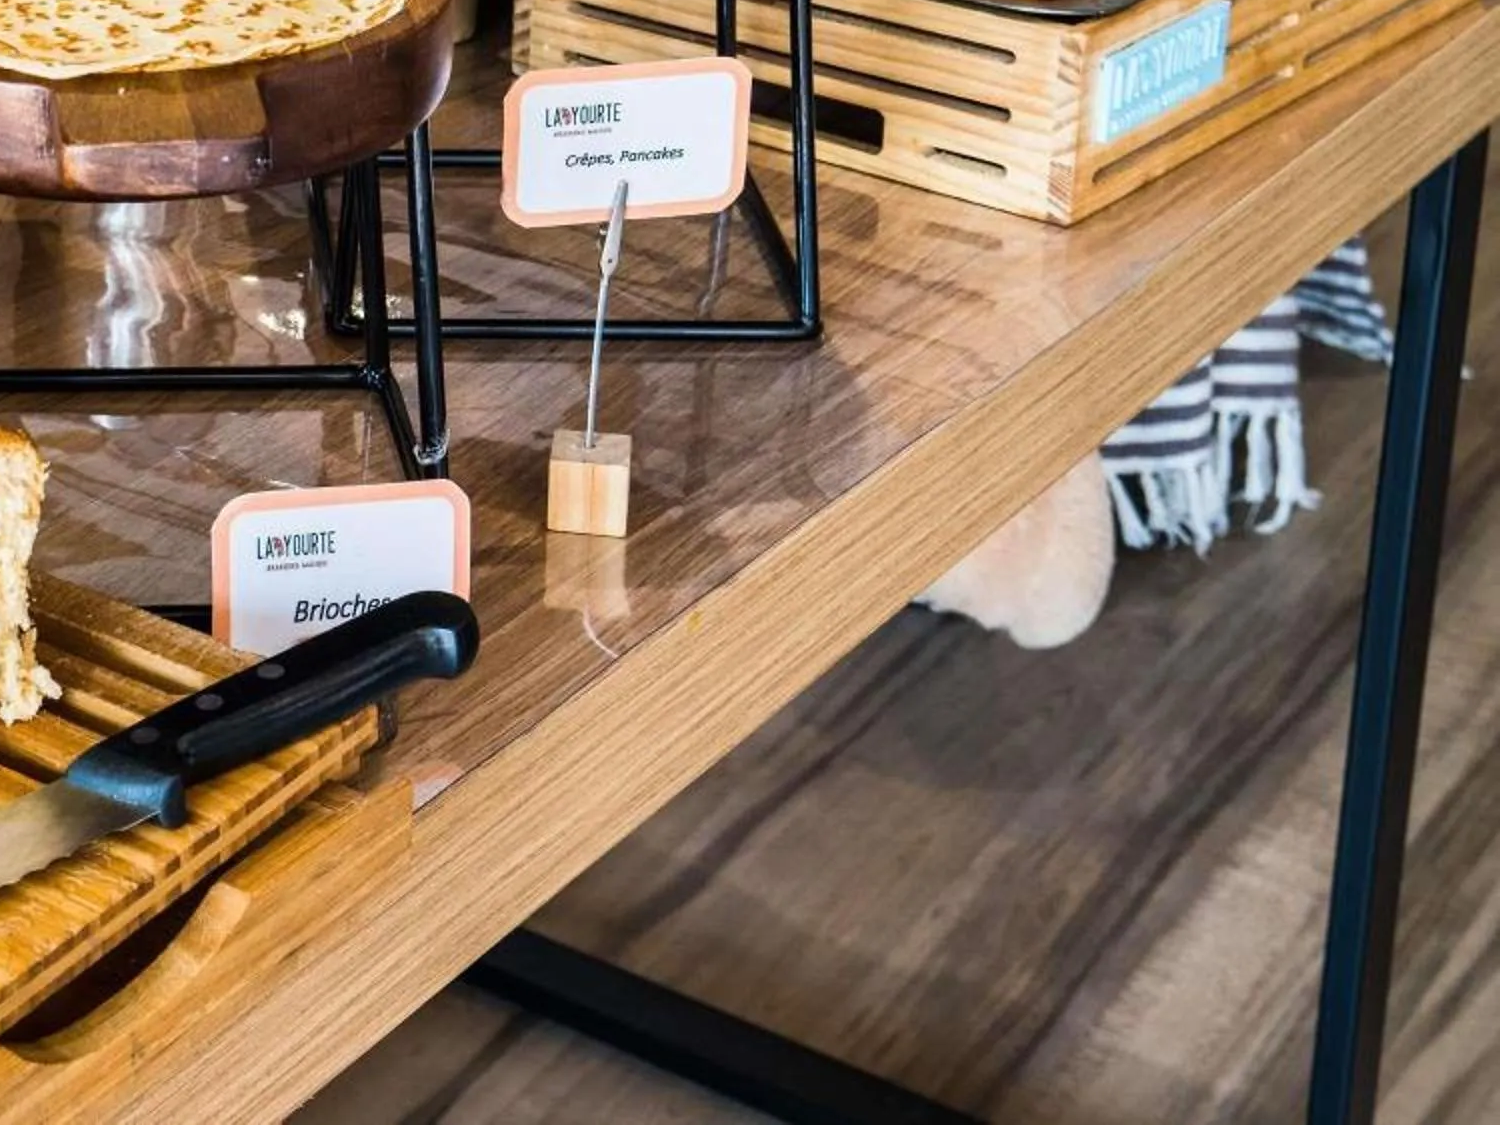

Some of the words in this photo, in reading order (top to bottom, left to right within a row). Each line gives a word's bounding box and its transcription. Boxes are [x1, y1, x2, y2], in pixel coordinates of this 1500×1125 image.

[571, 102, 623, 126] YOURTE
[619, 146, 685, 164] Pancakes
[283, 530, 337, 558] YOURTE
